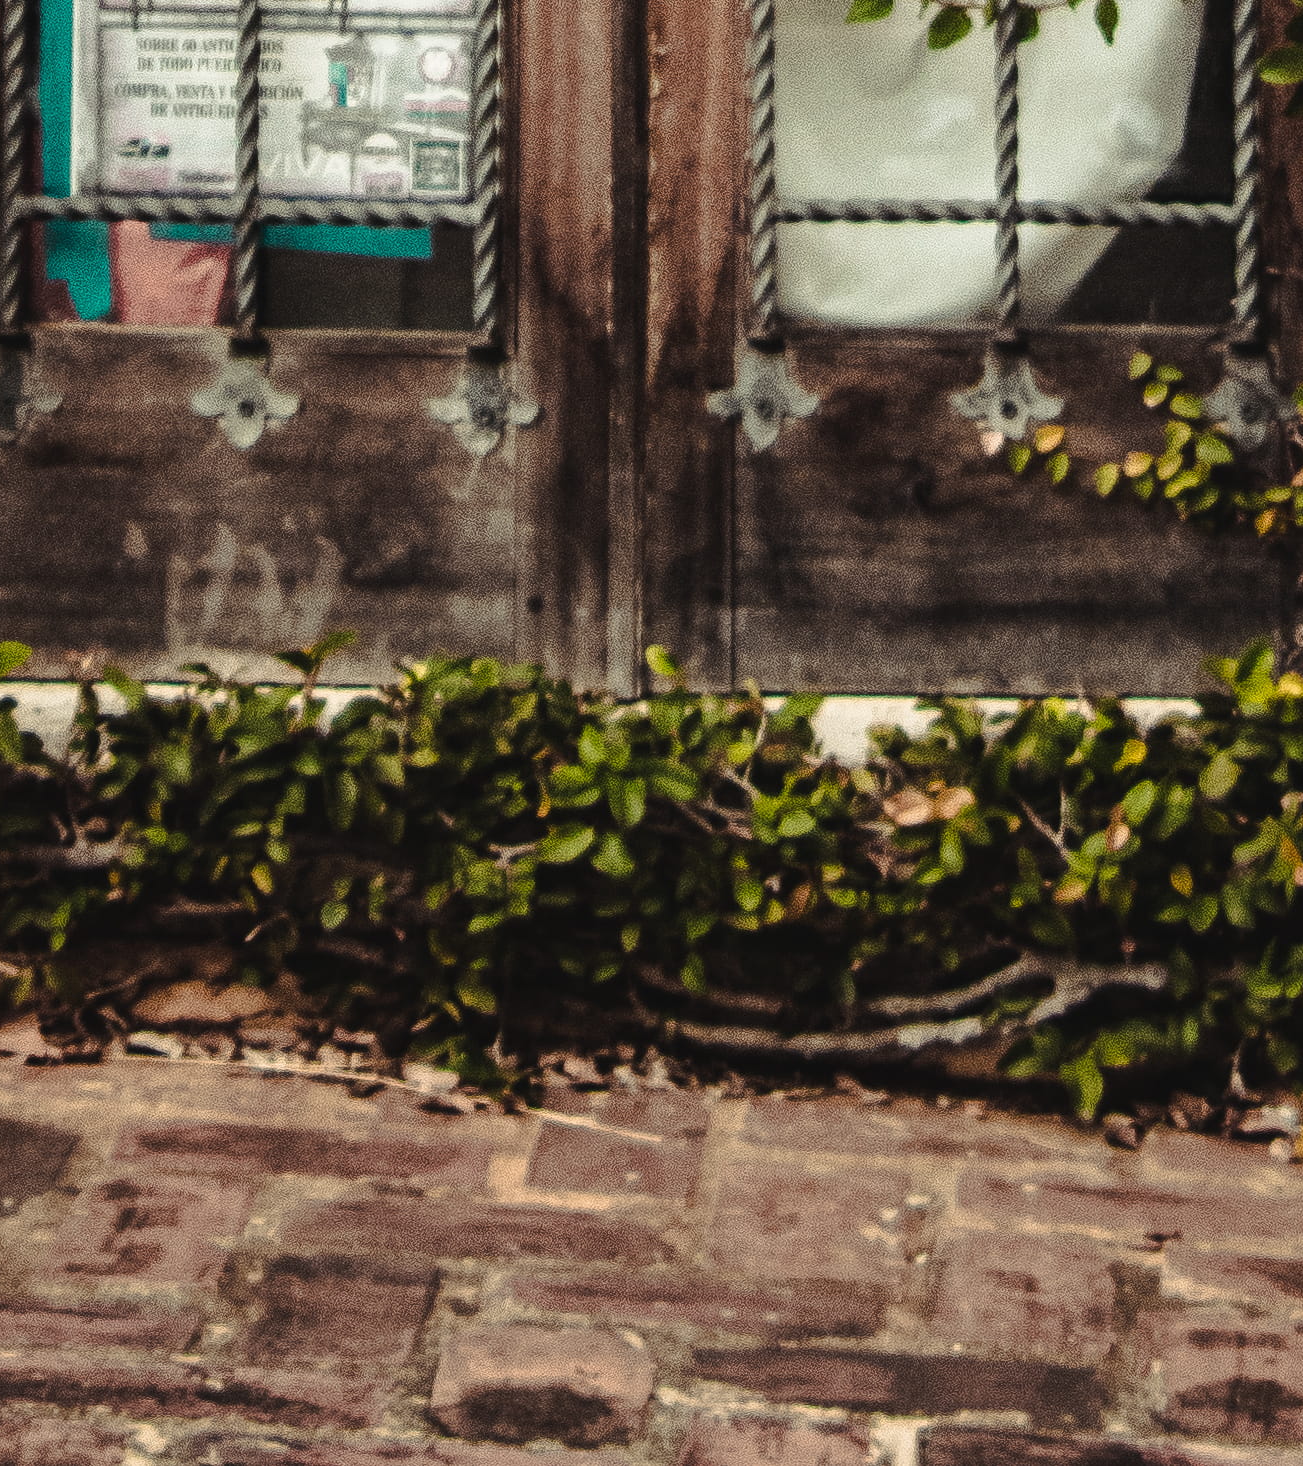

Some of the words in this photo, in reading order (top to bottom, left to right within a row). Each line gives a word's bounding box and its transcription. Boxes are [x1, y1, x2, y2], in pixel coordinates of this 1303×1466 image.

[136, 37, 178, 52] SOBRE
[137, 56, 155, 71] DE
[159, 56, 194, 71] TODO
[114, 82, 173, 100] COMPRA,
[175, 83, 216, 99] VENTA
[150, 102, 168, 117] DE
